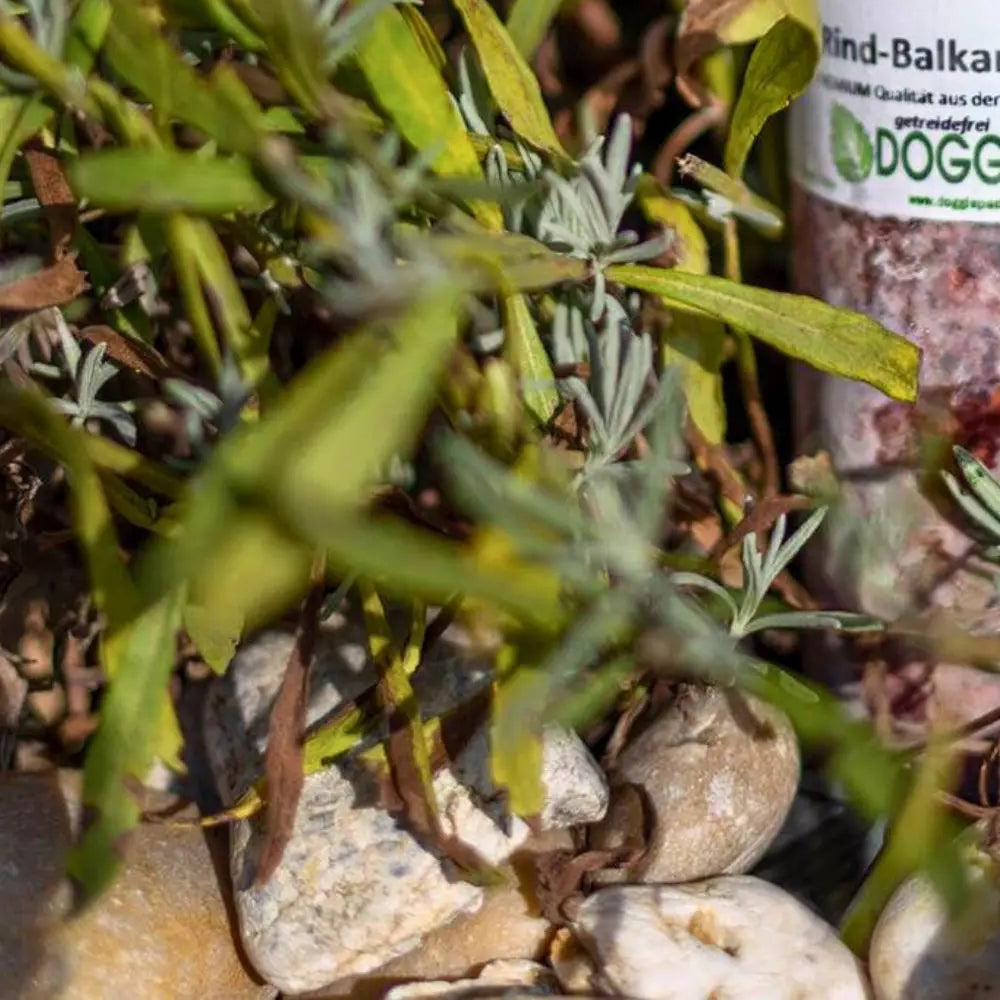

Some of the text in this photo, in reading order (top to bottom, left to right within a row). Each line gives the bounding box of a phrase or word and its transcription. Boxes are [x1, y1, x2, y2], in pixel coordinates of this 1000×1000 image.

[874, 84, 934, 105] Qualität
[938, 91, 968, 106] aus
[971, 88, 1000, 107] der
[894, 114, 991, 135] getreidefrei
